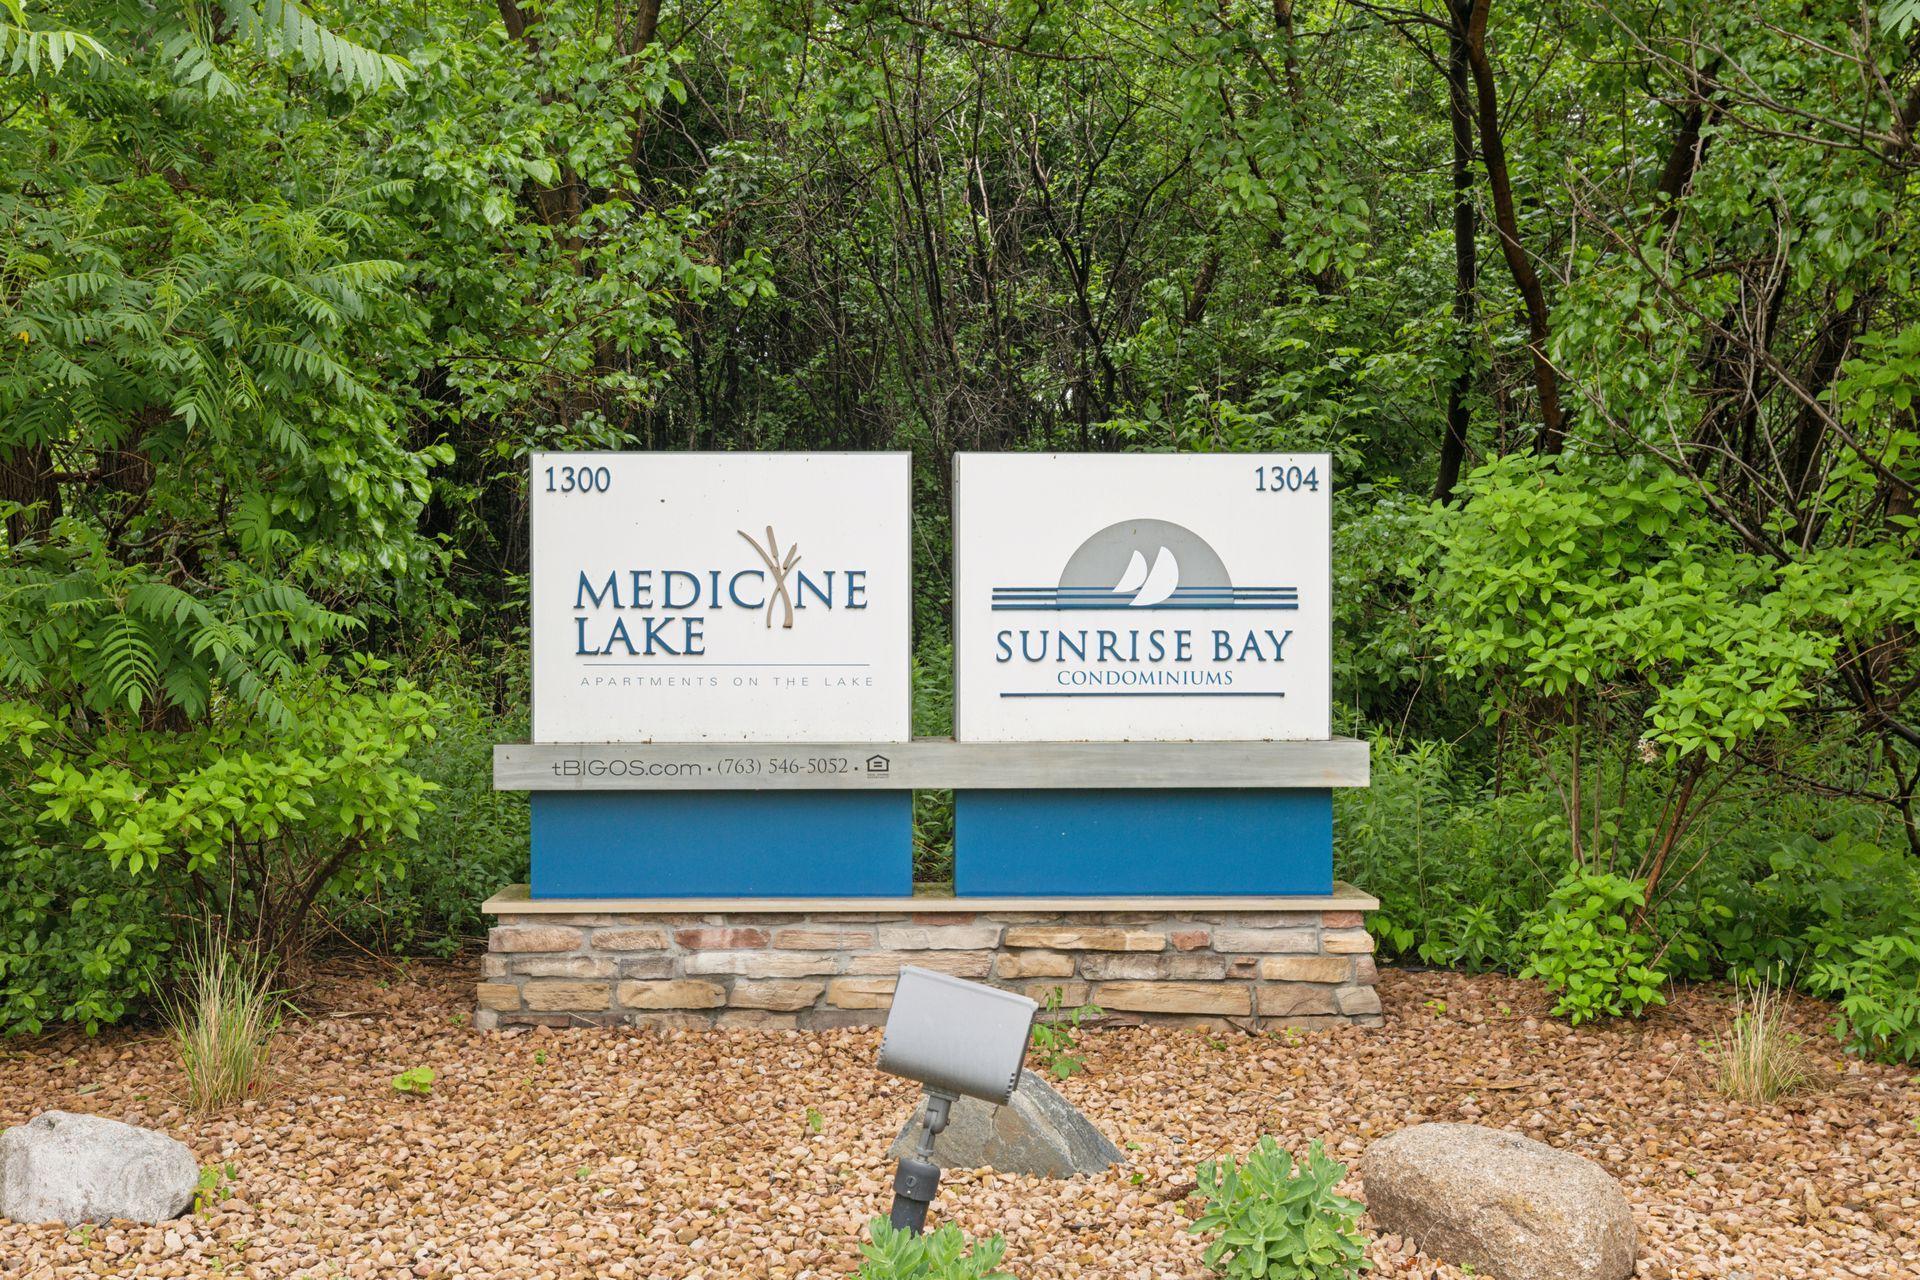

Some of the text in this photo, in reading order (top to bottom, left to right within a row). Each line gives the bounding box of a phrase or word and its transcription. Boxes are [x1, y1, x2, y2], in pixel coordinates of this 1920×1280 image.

[545, 466, 611, 493] 1300
[1255, 466, 1319, 492] 1304
[574, 616, 706, 656] LAKE
[996, 629, 1294, 663] SUNRISE BAY
[580, 676, 873, 687] APARTMENTS ON THE LAKE
[1057, 670, 1233, 686] CONDOMINIUMS
[552, 757, 849, 776] tBIGOS.com (763) 546-5052
